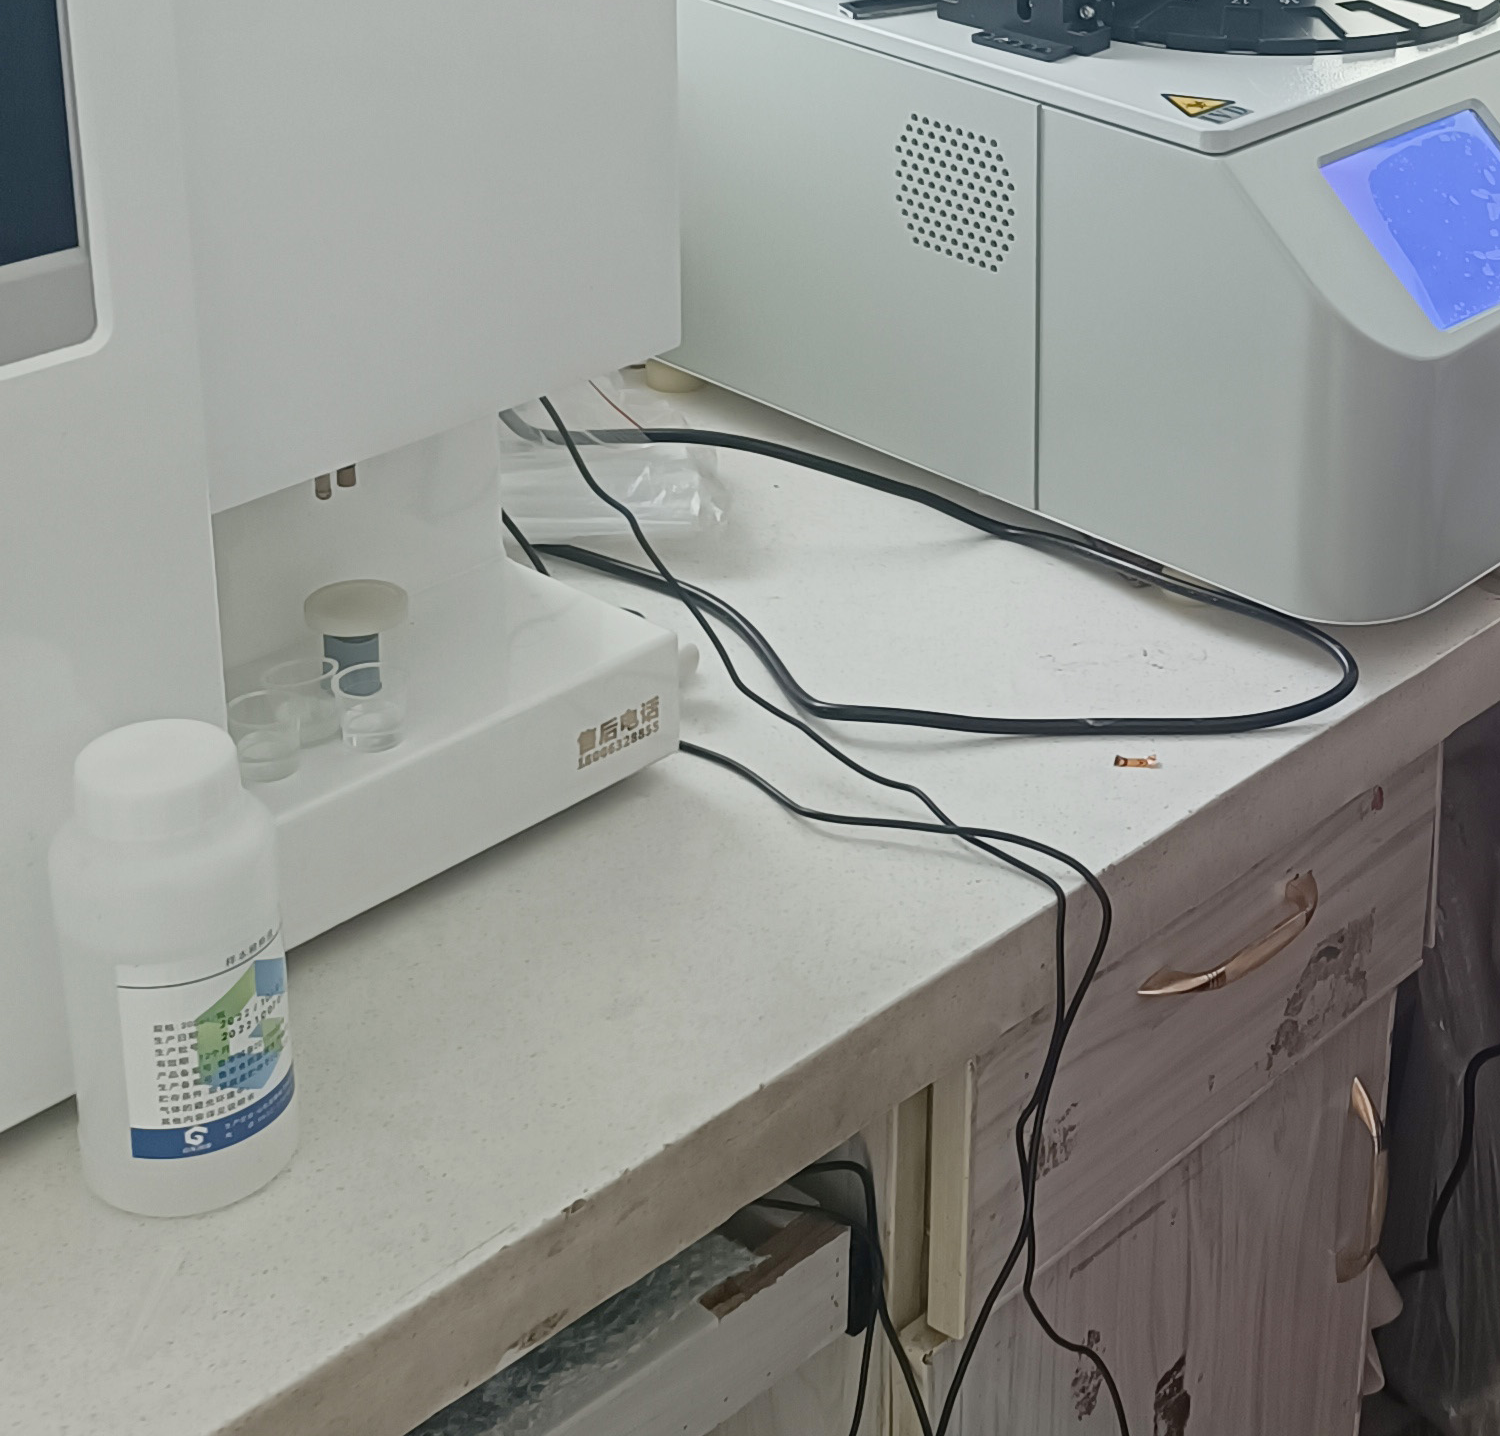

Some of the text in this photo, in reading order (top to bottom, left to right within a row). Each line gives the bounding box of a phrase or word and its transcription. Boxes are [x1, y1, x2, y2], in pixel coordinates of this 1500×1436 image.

[1200, 105, 1248, 124] IVD
[577, 695, 659, 755] 售后电话
